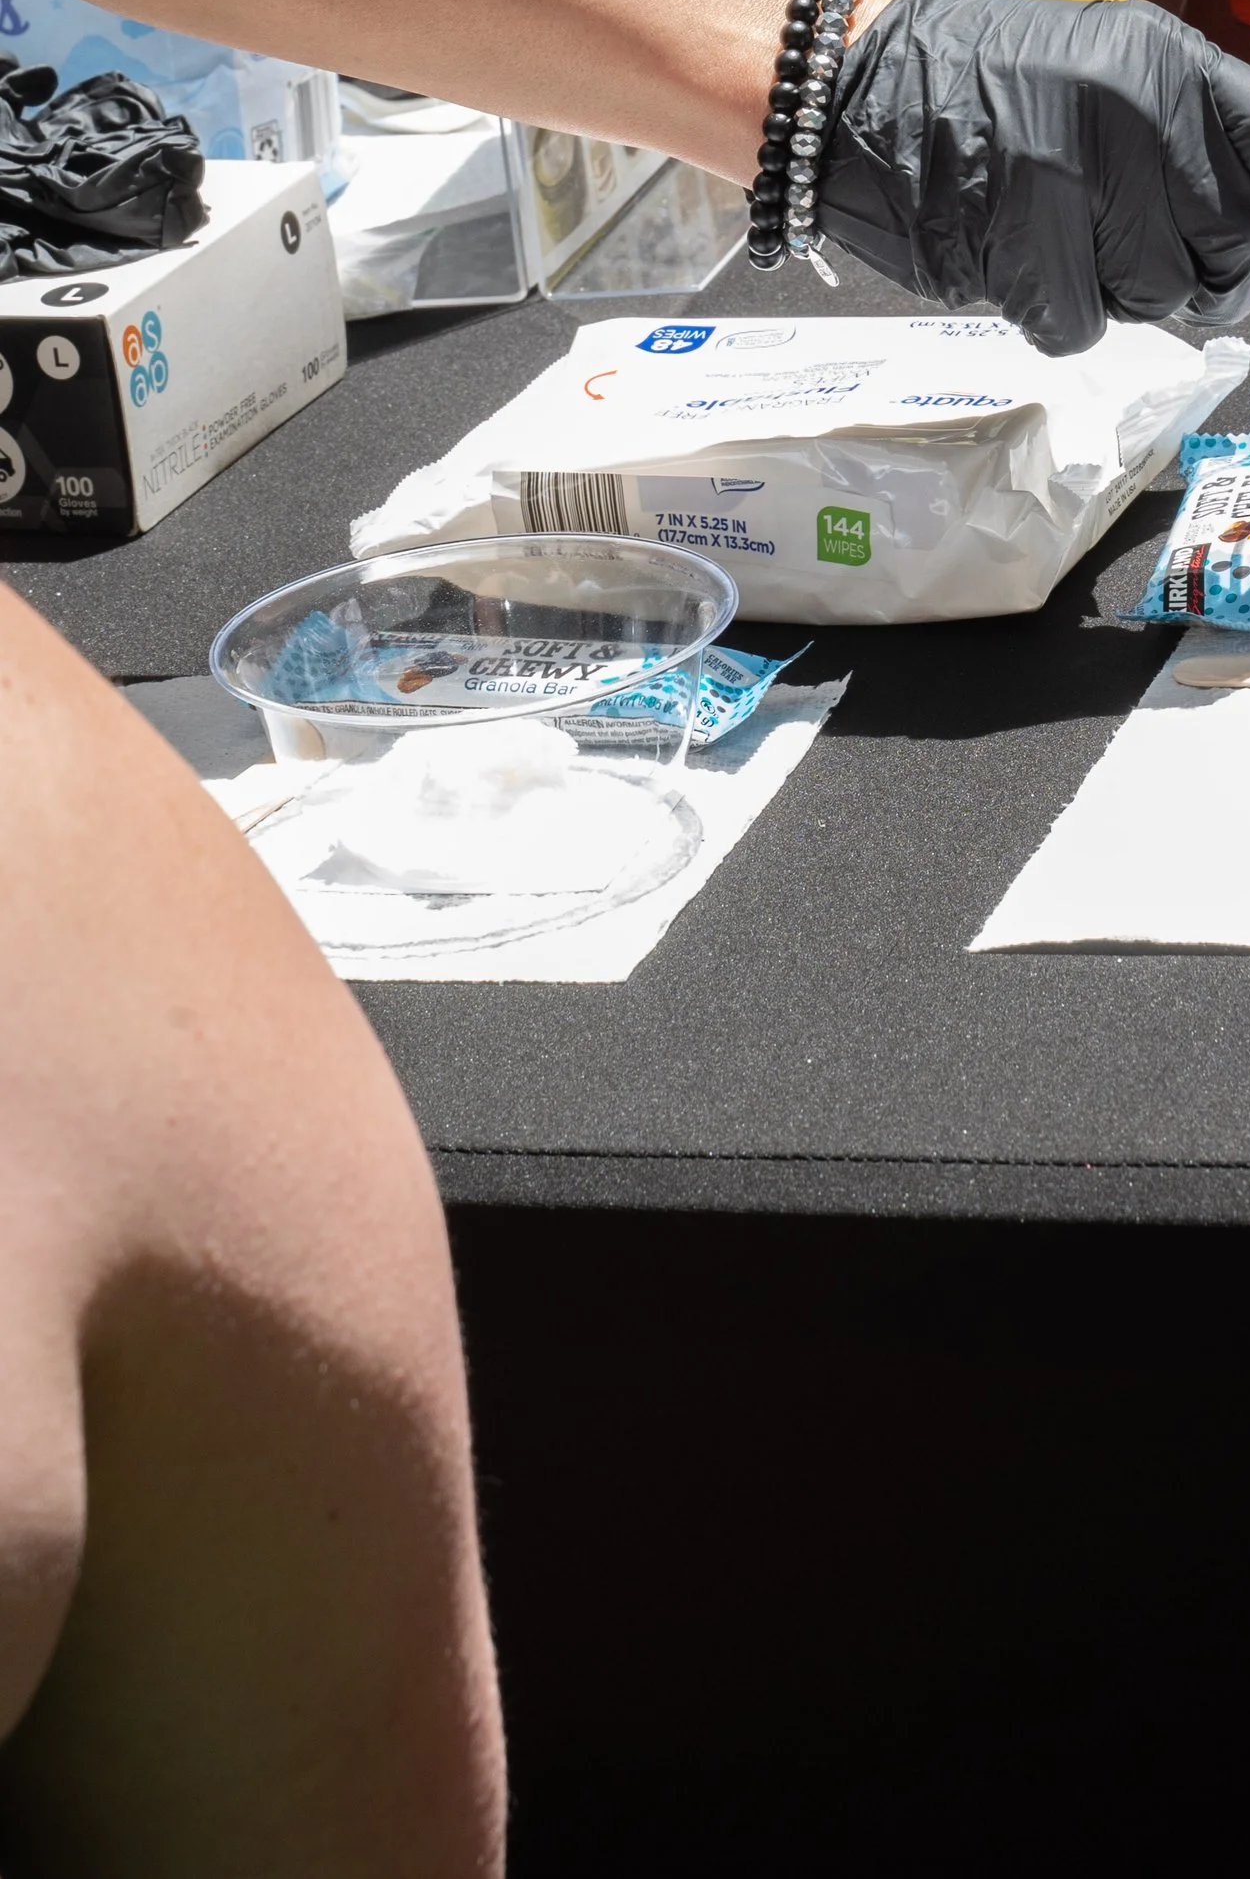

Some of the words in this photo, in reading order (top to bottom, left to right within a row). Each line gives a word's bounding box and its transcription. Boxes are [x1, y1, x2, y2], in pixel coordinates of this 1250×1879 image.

[650, 339, 693, 351] 48
[653, 329, 707, 340] WIPES
[52, 347, 70, 368] L
[302, 357, 320, 383] 100
[239, 392, 257, 412] FREE
[901, 394, 1013, 407] equate
[142, 433, 202, 501] NITRILE
[56, 476, 94, 497] 100
[58, 497, 97, 509] Gloves
[1191, 488, 1234, 521] SOFT
[655, 514, 664, 525] 7
[668, 513, 683, 526] IN
[686, 515, 697, 528] X
[700, 516, 729, 531] 5.25
[732, 519, 747, 534] IN
[823, 514, 865, 540] 144
[657, 529, 708, 546] (17.7cm
[710, 533, 722, 548] X
[724, 535, 776, 556] 13.3cm)
[823, 539, 866, 560] WIPES
[503, 639, 591, 660] SOFT
[469, 657, 608, 681] CHEWY
[704, 659, 720, 672] PER
[720, 669, 738, 684] BAR
[708, 654, 744, 680] CALORIES
[464, 677, 537, 694] Granola
[543, 682, 579, 696] Bar
